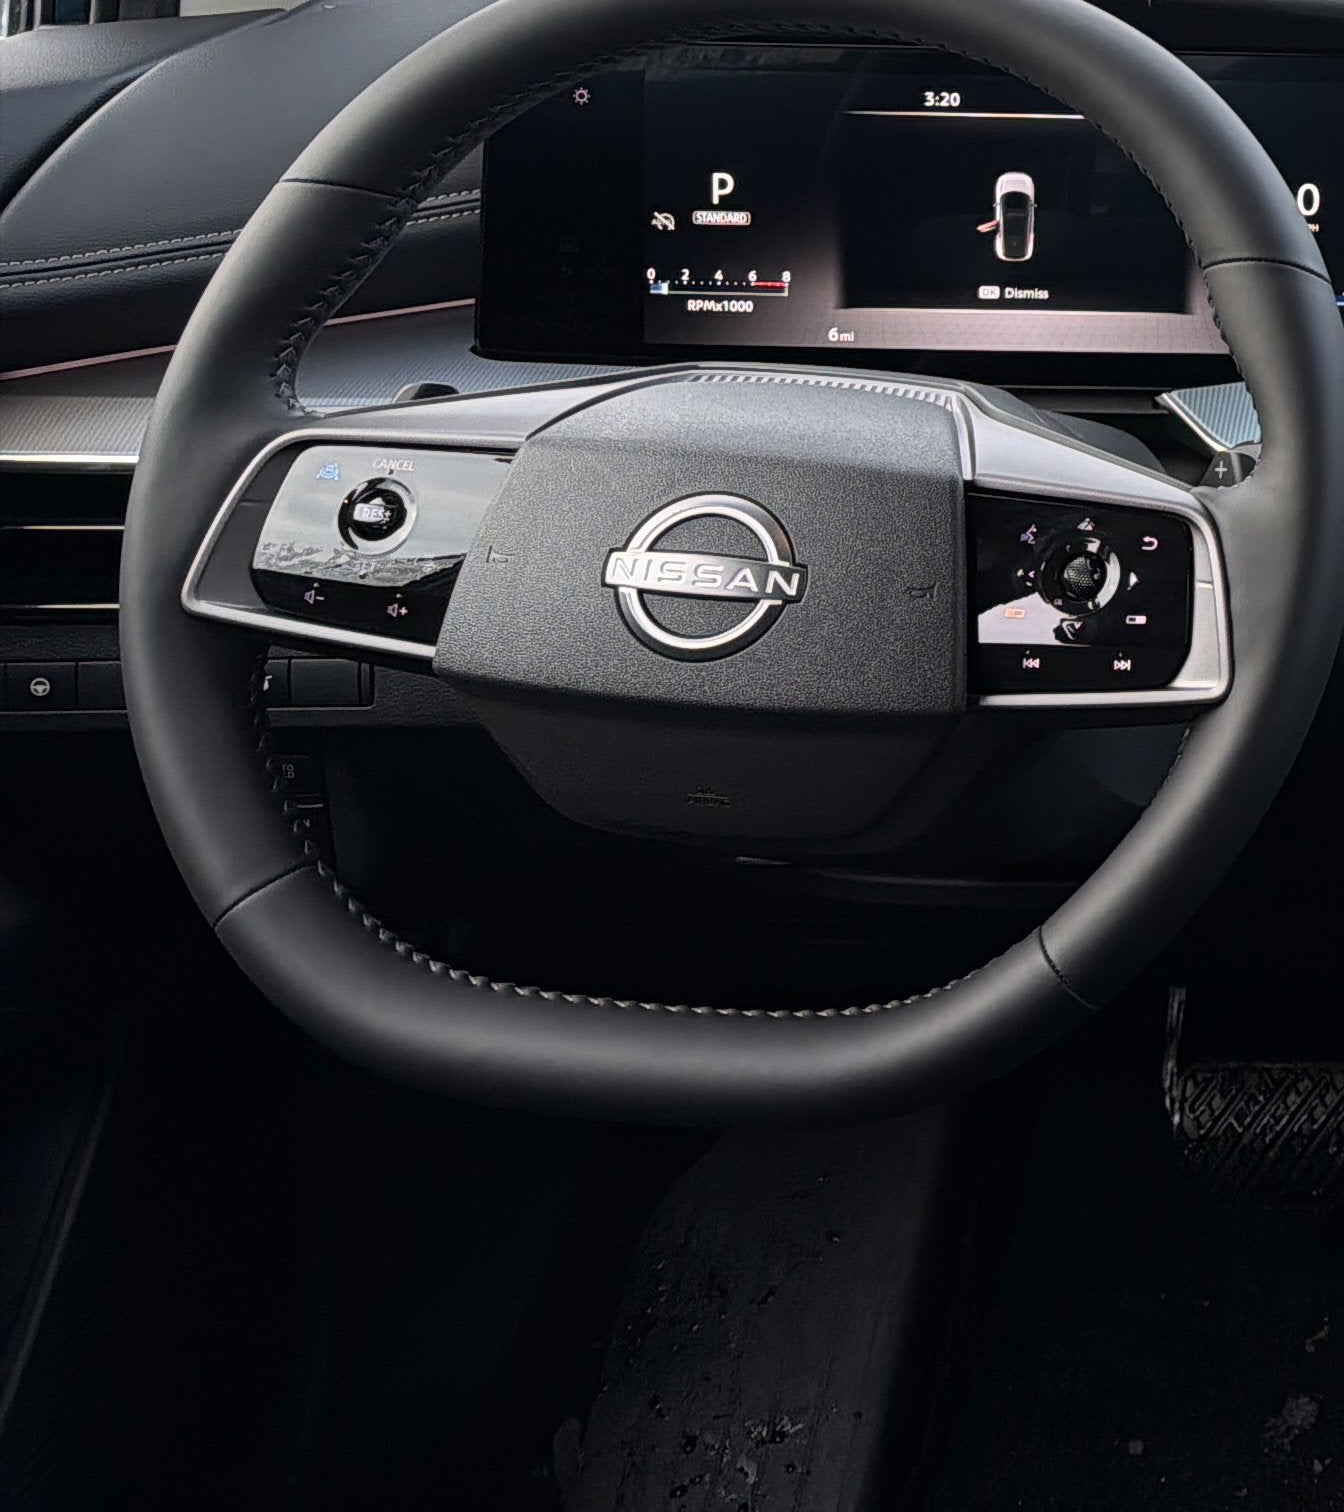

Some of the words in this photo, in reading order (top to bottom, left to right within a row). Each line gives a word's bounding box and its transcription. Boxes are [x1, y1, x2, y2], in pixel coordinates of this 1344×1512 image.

[923, 91, 961, 108] 3:20
[711, 172, 735, 205] P
[1296, 183, 1320, 216] 0
[695, 211, 749, 225] STANDARD
[646, 267, 656, 280] 0
[680, 268, 690, 281] 2
[714, 269, 724, 280] 4
[748, 270, 757, 282] 6
[782, 270, 791, 283] 8
[1004, 286, 1049, 299] Dismiss
[687, 299, 754, 313] RPMx1000
[372, 458, 415, 472] CANCEL
[610, 557, 798, 597] NISSAN
